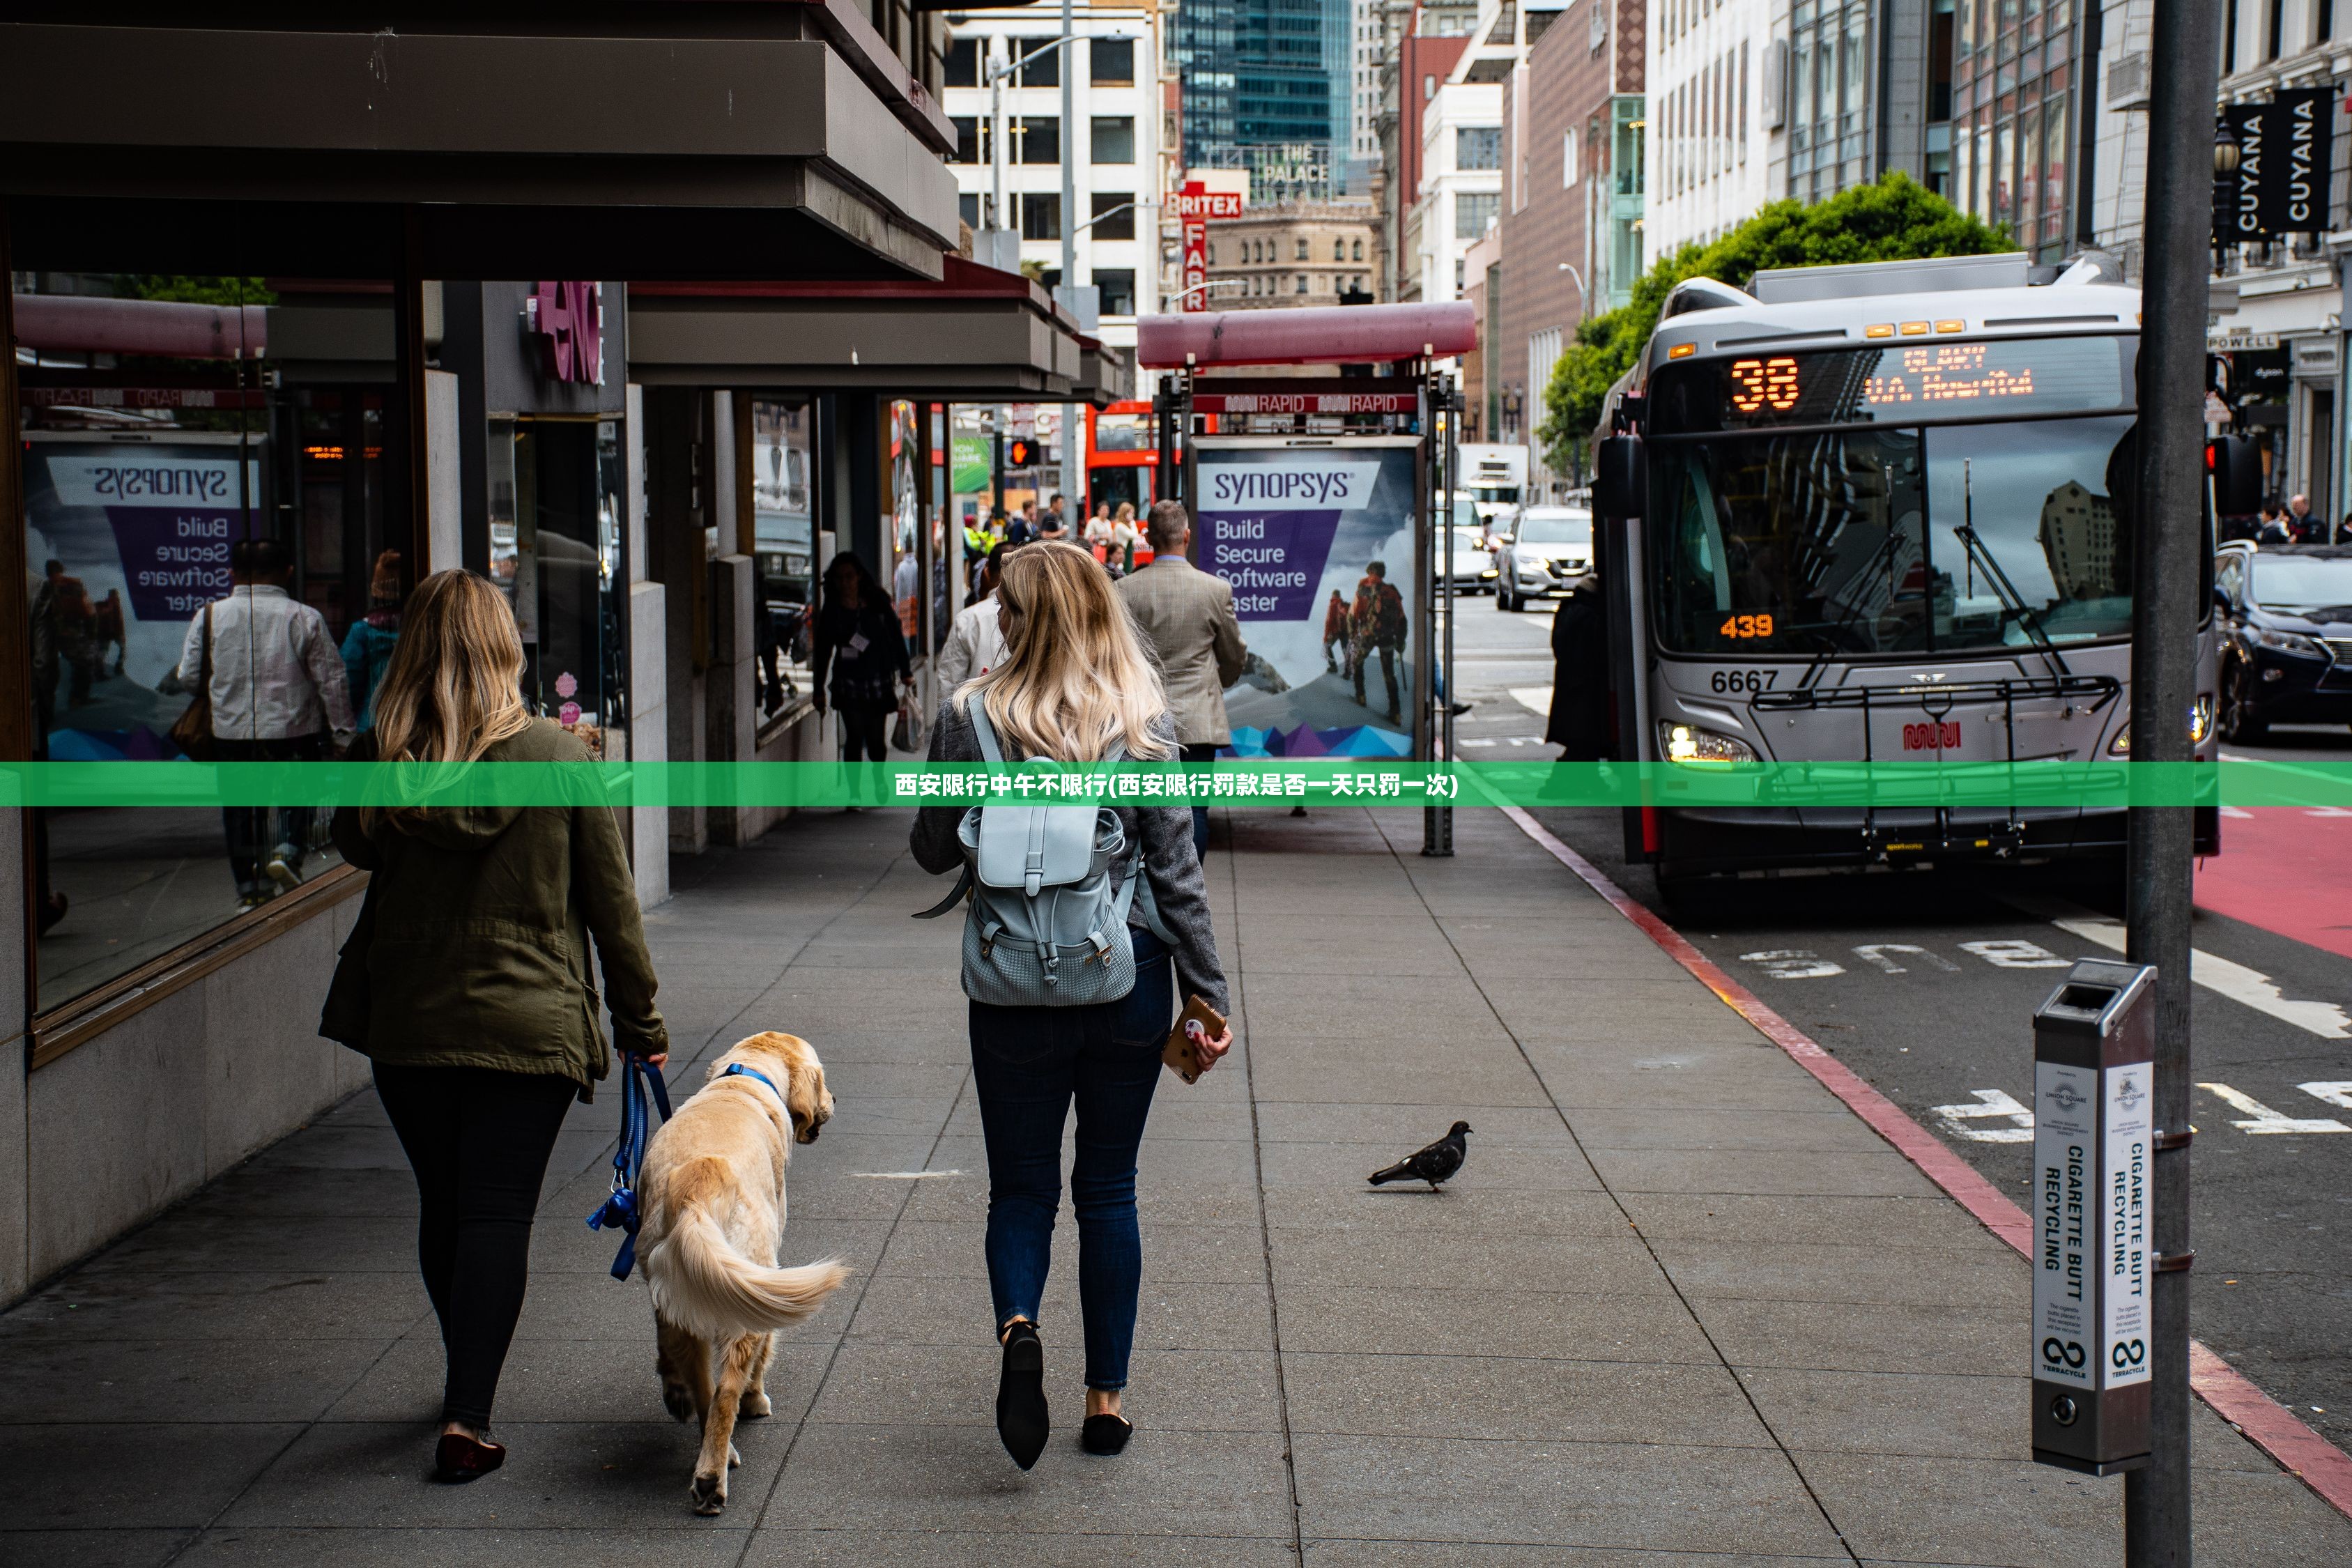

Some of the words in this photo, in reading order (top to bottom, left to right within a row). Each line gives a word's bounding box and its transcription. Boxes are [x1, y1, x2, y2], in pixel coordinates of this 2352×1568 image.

[1282, 144, 1313, 162] THE
[2289, 100, 2314, 222] CUYANA
[1263, 165, 1328, 182] PALACE
[2238, 115, 2263, 232] CUYANA
[1166, 192, 1239, 216] BRITEX
[2208, 336, 2274, 348] POWELL
[1732, 358, 1799, 411] 38
[2254, 367, 2284, 379] dyson
[1259, 395, 1305, 413] RAPID
[1352, 395, 1397, 412] RAPID
[1215, 472, 1348, 504] SYNOPSYS
[1215, 520, 1264, 540] Build
[1215, 544, 1285, 564] Secure
[1215, 567, 1307, 588] Software
[1233, 595, 1279, 612] aster
[1720, 614, 1773, 638] 439
[1710, 670, 1778, 693] 6667
[2129, 1092, 2145, 1100] SQUARE
[2068, 1145, 2083, 1247] CIGARETTE
[2131, 1143, 2143, 1245] CIGARETTE
[2045, 1167, 2061, 1271] RECYCLING
[2114, 1171, 2126, 1275] RECYCLING
[2068, 1253, 2082, 1302] BUTT
[2130, 1250, 2142, 1297] BUTT
[2042, 1364, 2086, 1379] TERRACYCLE
[2112, 1366, 2145, 1378] TERRACYCLE
